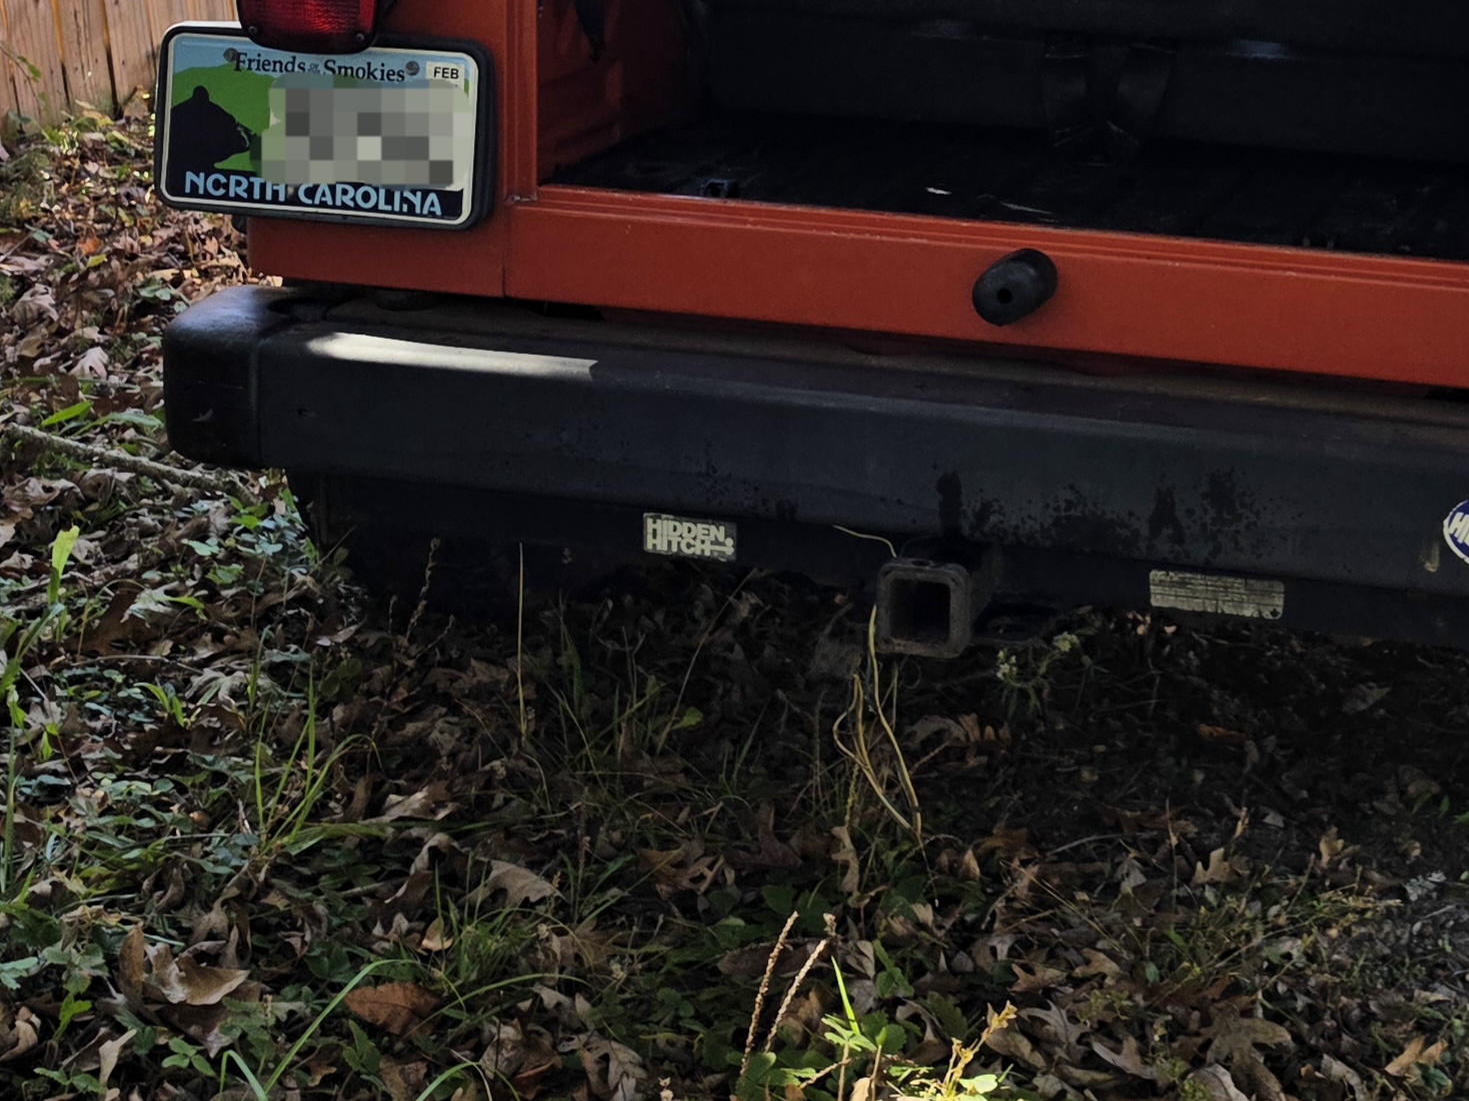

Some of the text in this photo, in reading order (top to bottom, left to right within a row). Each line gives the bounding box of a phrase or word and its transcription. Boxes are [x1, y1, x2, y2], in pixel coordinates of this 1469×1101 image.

[234, 52, 306, 73] Friends
[323, 59, 405, 83] Smokies
[433, 66, 460, 80] FEB
[184, 170, 442, 216] NORTH CAROLINA
[647, 518, 724, 541] HIDDEN
[647, 533, 711, 555] HITCH
